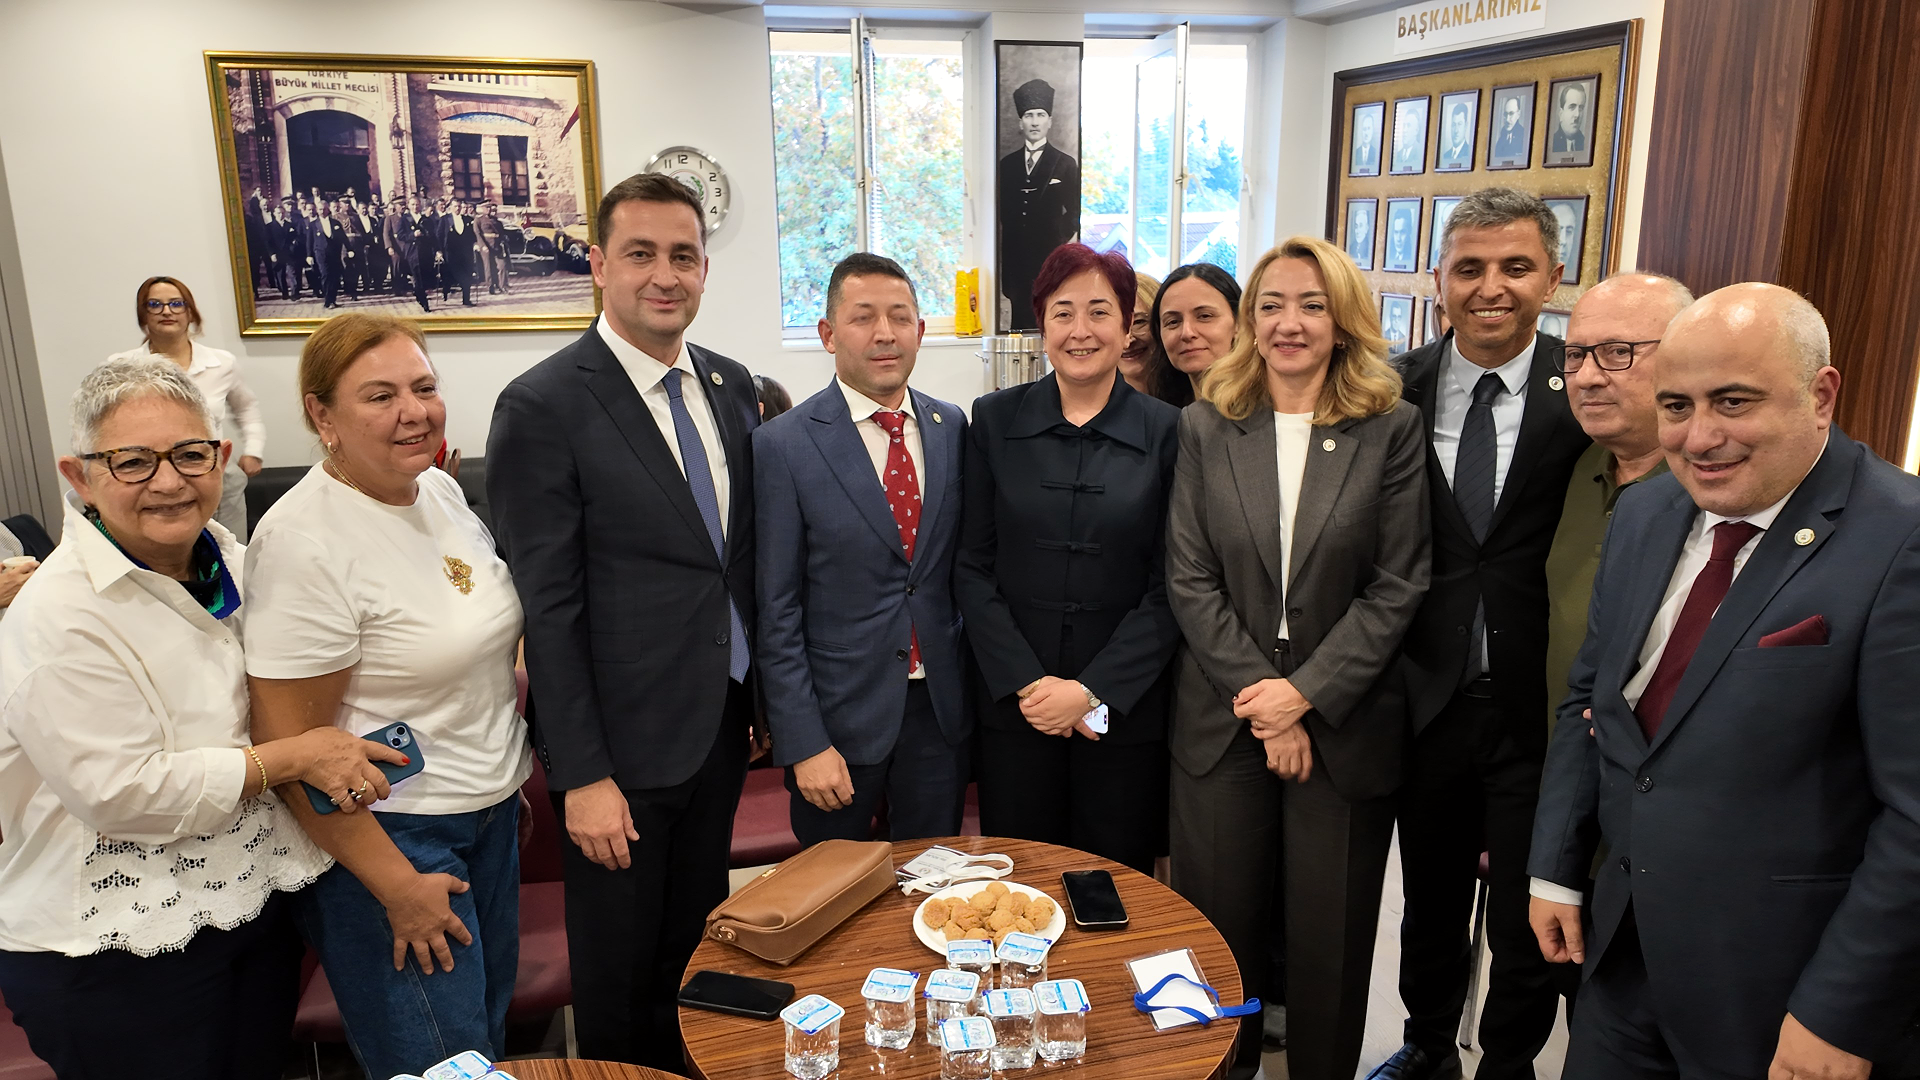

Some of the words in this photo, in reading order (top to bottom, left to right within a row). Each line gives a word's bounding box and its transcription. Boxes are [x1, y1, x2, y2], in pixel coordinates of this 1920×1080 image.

[1398, 0, 1541, 40] BAŞKANLARIMIZ
[275, 77, 308, 88] BÜYÜK
[311, 80, 341, 91] MİLLET
[345, 83, 379, 93] MECLİSİ
[664, 159, 672, 169] 11
[677, 154, 689, 164] 12
[709, 172, 717, 182] 2
[714, 187, 722, 197] 3
[710, 206, 718, 215] 4
